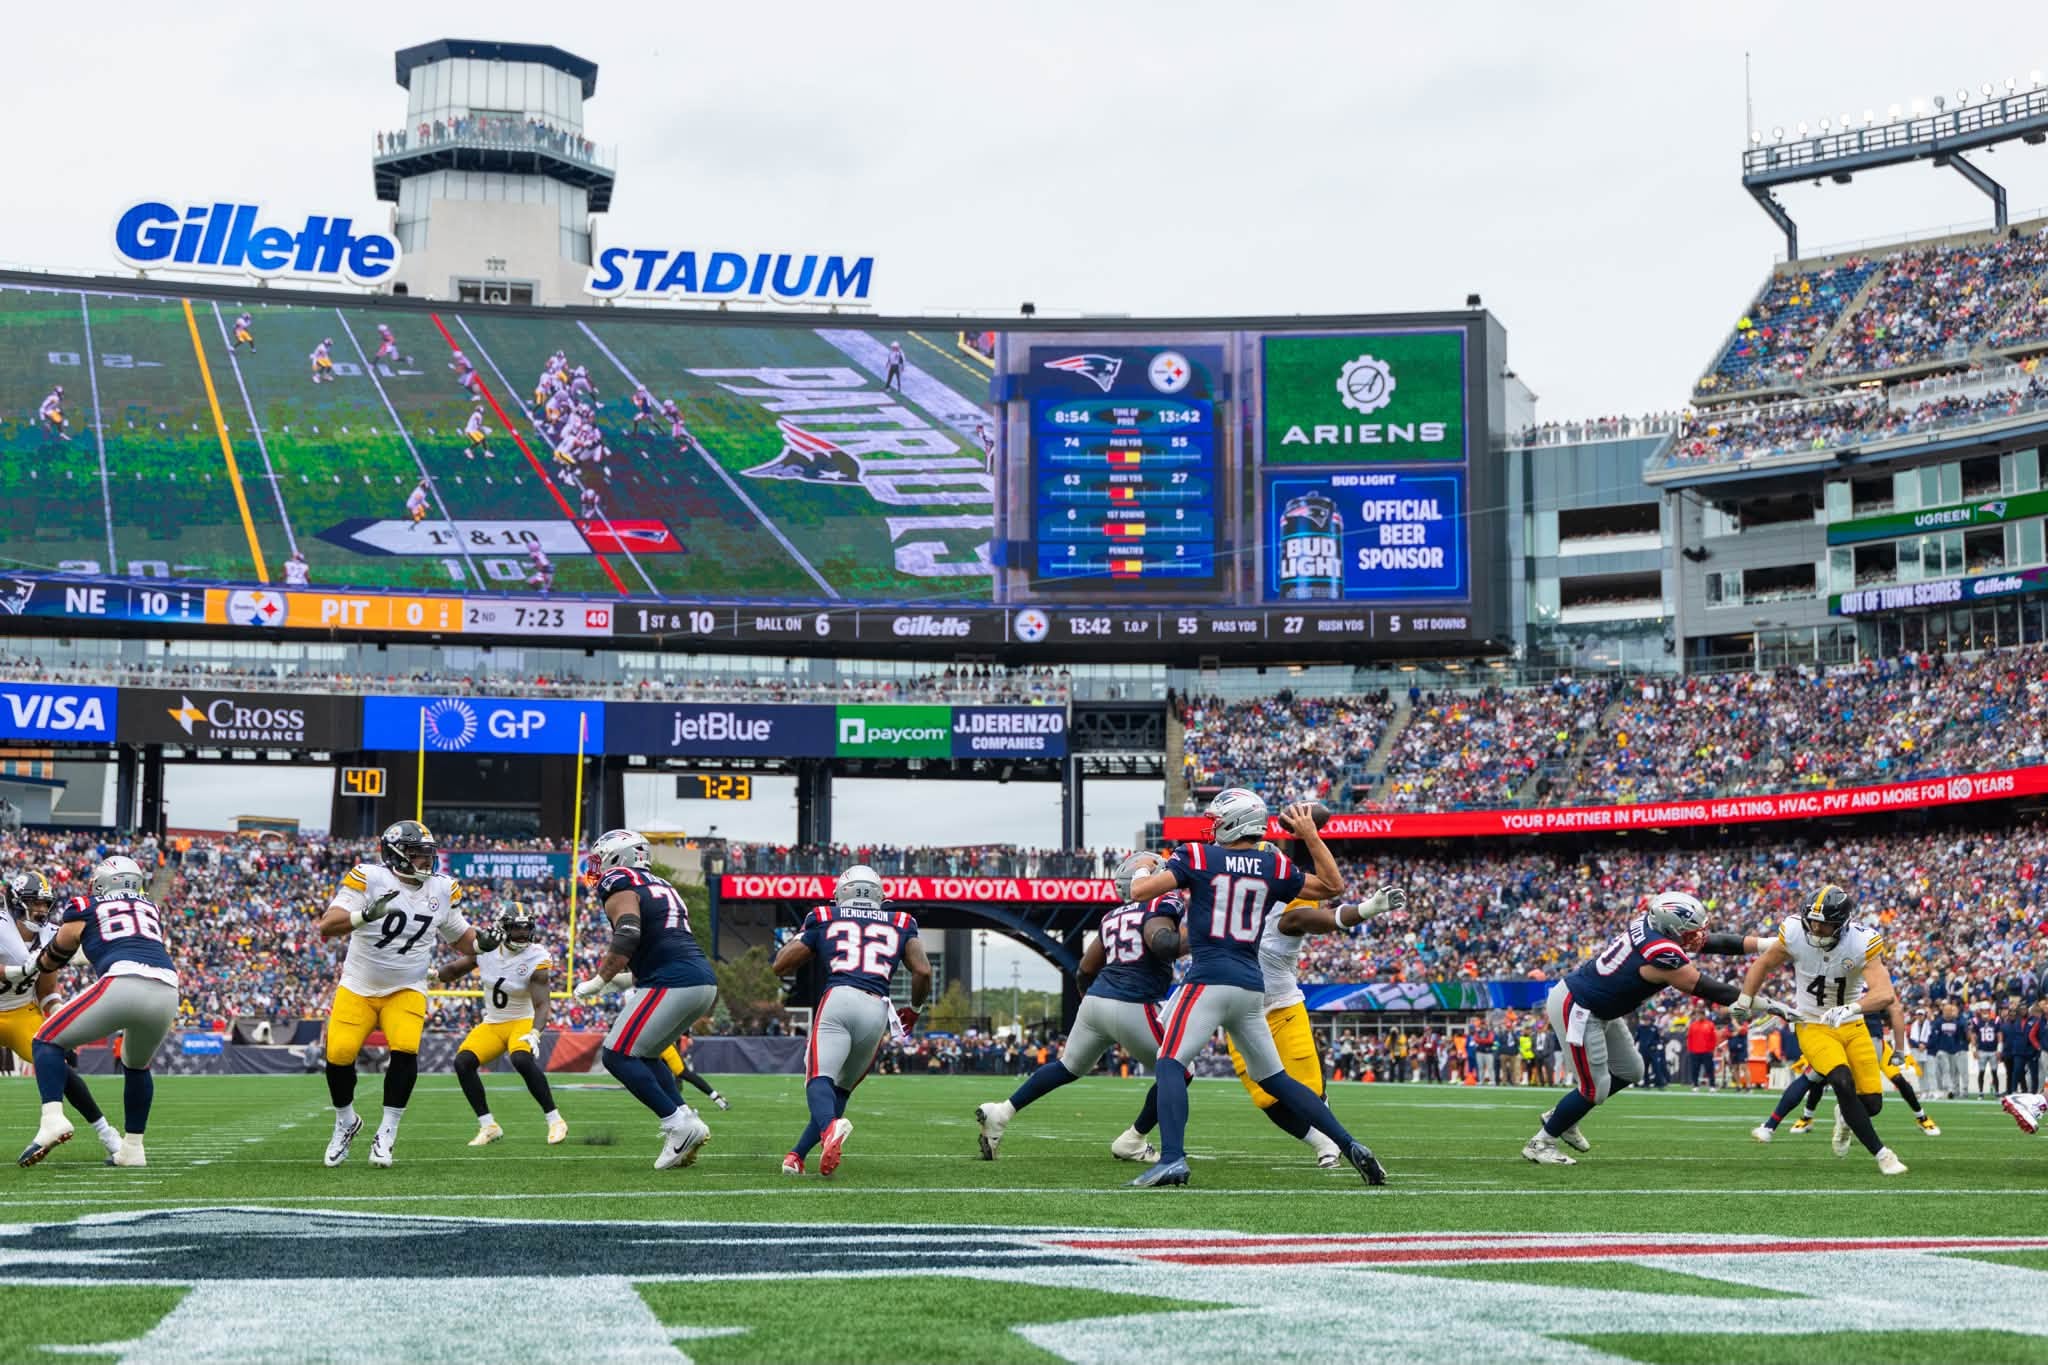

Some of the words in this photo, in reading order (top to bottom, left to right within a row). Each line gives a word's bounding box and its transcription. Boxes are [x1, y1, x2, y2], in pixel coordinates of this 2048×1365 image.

[116, 202, 394, 278] Gillette
[592, 248, 873, 298] STADIUM
[1054, 411, 1090, 423] 8:54
[1159, 411, 1201, 423] 13:42
[1064, 437, 1080, 447] 74
[1171, 437, 1188, 447] 55
[1281, 422, 1445, 446] ARIENS
[1063, 474, 1081, 485] 63
[1171, 473, 1188, 484] 27
[1332, 475, 1358, 486] BUD
[1360, 474, 1397, 486] LIGHT
[1068, 509, 1076, 519] 6
[1176, 509, 1184, 519] 5
[1362, 499, 1442, 523] OFFICIAL
[1914, 508, 1970, 527] UGREEN
[470, 530, 494, 546] &
[502, 530, 539, 546] 10
[1379, 523, 1426, 546] BEER
[1068, 545, 1076, 556] 2
[1176, 545, 1184, 556] 2
[1286, 537, 1337, 557] BUD
[1281, 556, 1342, 579] LIGHT
[1358, 547, 1443, 570] SPONSOR
[1973, 576, 2023, 595] Gillette
[65, 587, 106, 614] NE
[140, 592, 169, 616] 10
[1841, 591, 1864, 614] OUT
[1864, 589, 1880, 612] OF
[1880, 585, 1914, 610] TOWN
[1914, 580, 1962, 607] SCORES
[321, 599, 370, 625] PIT
[406, 603, 424, 625] 0
[514, 608, 565, 628] 7:23
[587, 612, 609, 626] 40
[671, 617, 681, 628] &
[689, 611, 715, 633] 10
[755, 617, 782, 631] BALL
[784, 617, 802, 631] ON
[815, 614, 830, 636] 6
[892, 616, 972, 636] Gillette
[1069, 617, 1112, 635] 13:42
[1177, 617, 1198, 635] 55
[1212, 621, 1237, 632] PASS
[1283, 616, 1305, 634] 27
[1318, 619, 1344, 632] RUSH
[1389, 615, 1401, 632] 5
[1412, 618, 1428, 630] 1ST
[1430, 617, 1467, 630] DOWNS
[3, 694, 106, 731] VISA
[671, 711, 770, 746] jetBlue
[953, 713, 1063, 734] J.DERENZO
[209, 729, 305, 742] INSURANCE
[867, 725, 942, 744] paycom
[971, 736, 1044, 751] COMPANIES
[347, 769, 381, 794] 40
[698, 774, 750, 800] 7:23
[1502, 814, 1543, 829] YOUR
[1546, 810, 1611, 827] PARTNER
[1614, 809, 1629, 824] IN
[1633, 805, 1709, 823] PLUMBING,
[1711, 800, 1776, 818] HEATING,
[1779, 797, 1822, 814] HVAC,
[1824, 794, 1849, 810] PVF
[1851, 792, 1881, 808] AND
[1882, 787, 1919, 805] MORE
[1921, 784, 1945, 800] FOR
[1973, 775, 2015, 794] YEARS
[465, 864, 488, 877] U.S.
[491, 865, 513, 878] AIR
[516, 865, 555, 878] FORCE
[1225, 855, 1263, 875] MAYE
[732, 877, 825, 898] TOYOTA
[930, 878, 1020, 899] TOYOTA
[1028, 879, 1118, 900] TOYOTA
[855, 888, 870, 898] 32
[840, 907, 889, 922] HENDERSON
[1210, 873, 1270, 943] 10
[96, 900, 163, 944] 66
[373, 909, 434, 955] 97
[826, 920, 900, 980] 32
[492, 976, 509, 1010] 6
[1806, 974, 1847, 1007] 41
[1979, 1026, 1995, 1042] 16
